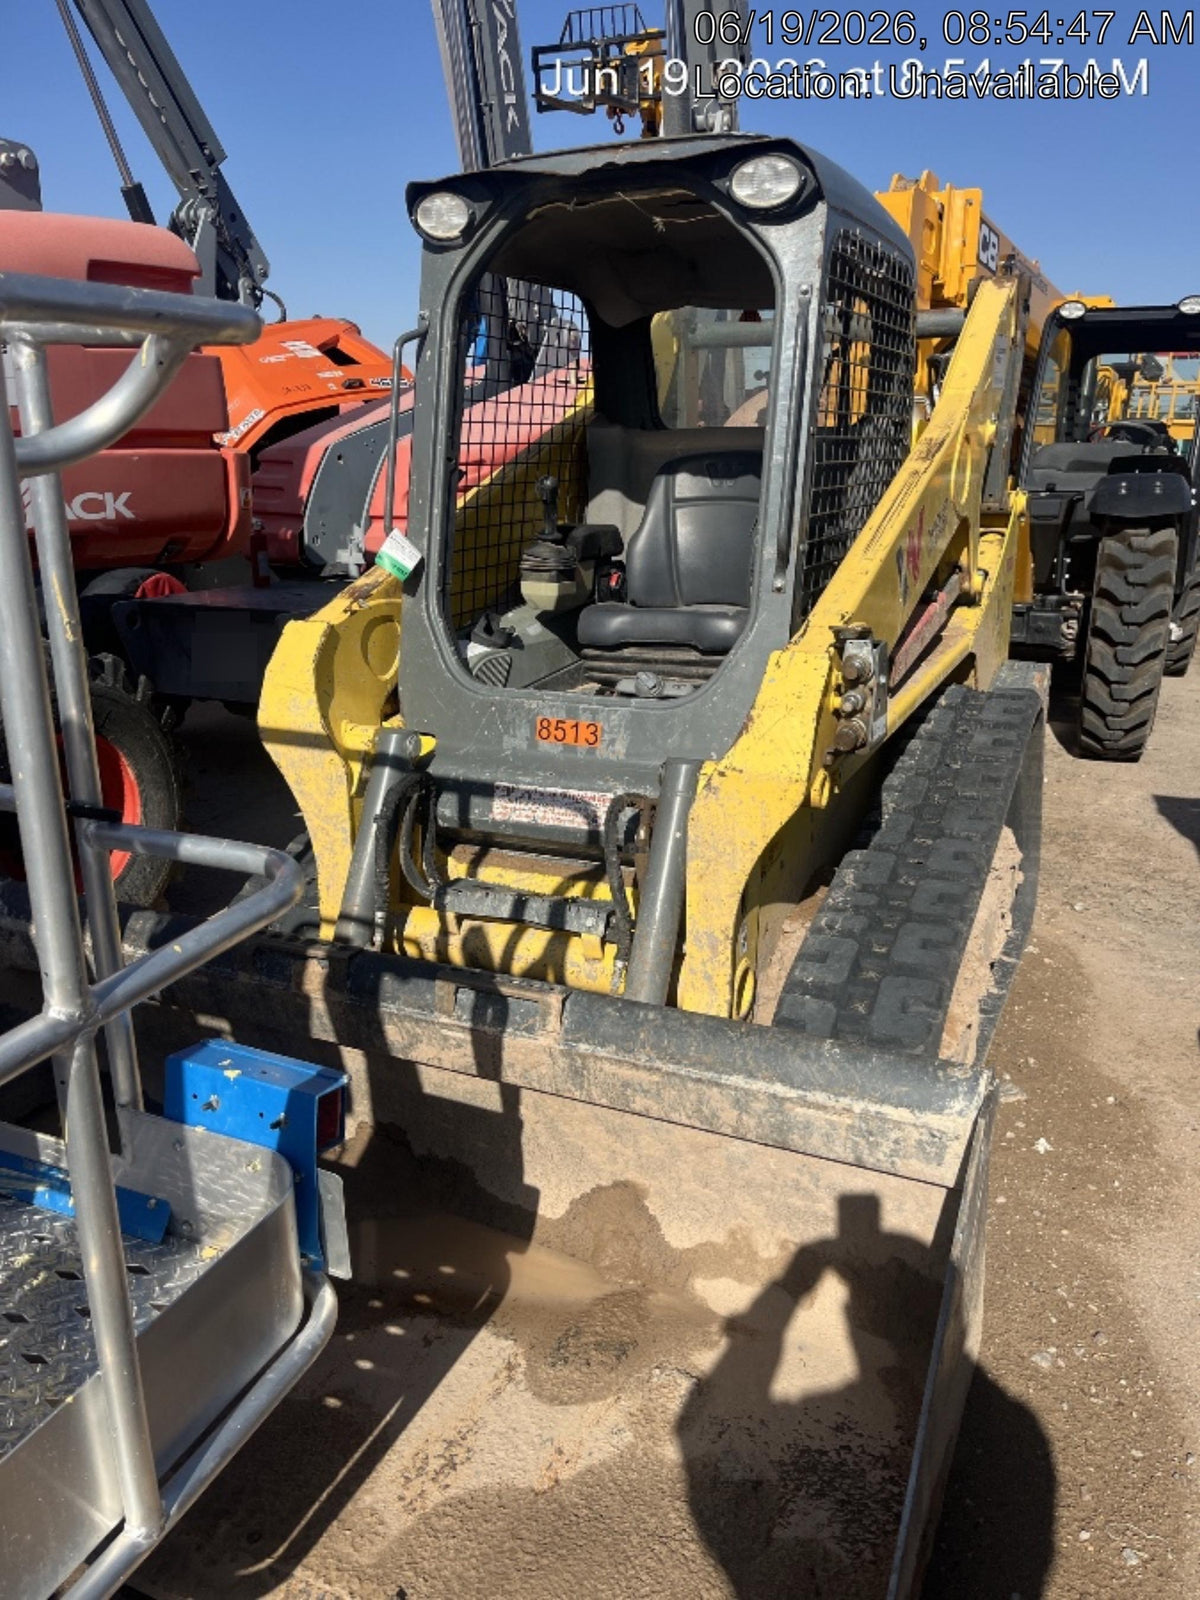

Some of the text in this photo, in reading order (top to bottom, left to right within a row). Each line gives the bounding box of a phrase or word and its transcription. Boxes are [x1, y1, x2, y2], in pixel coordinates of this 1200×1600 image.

[492, 0, 520, 134] ACK
[979, 222, 999, 274] CB
[537, 717, 600, 746] 8513
